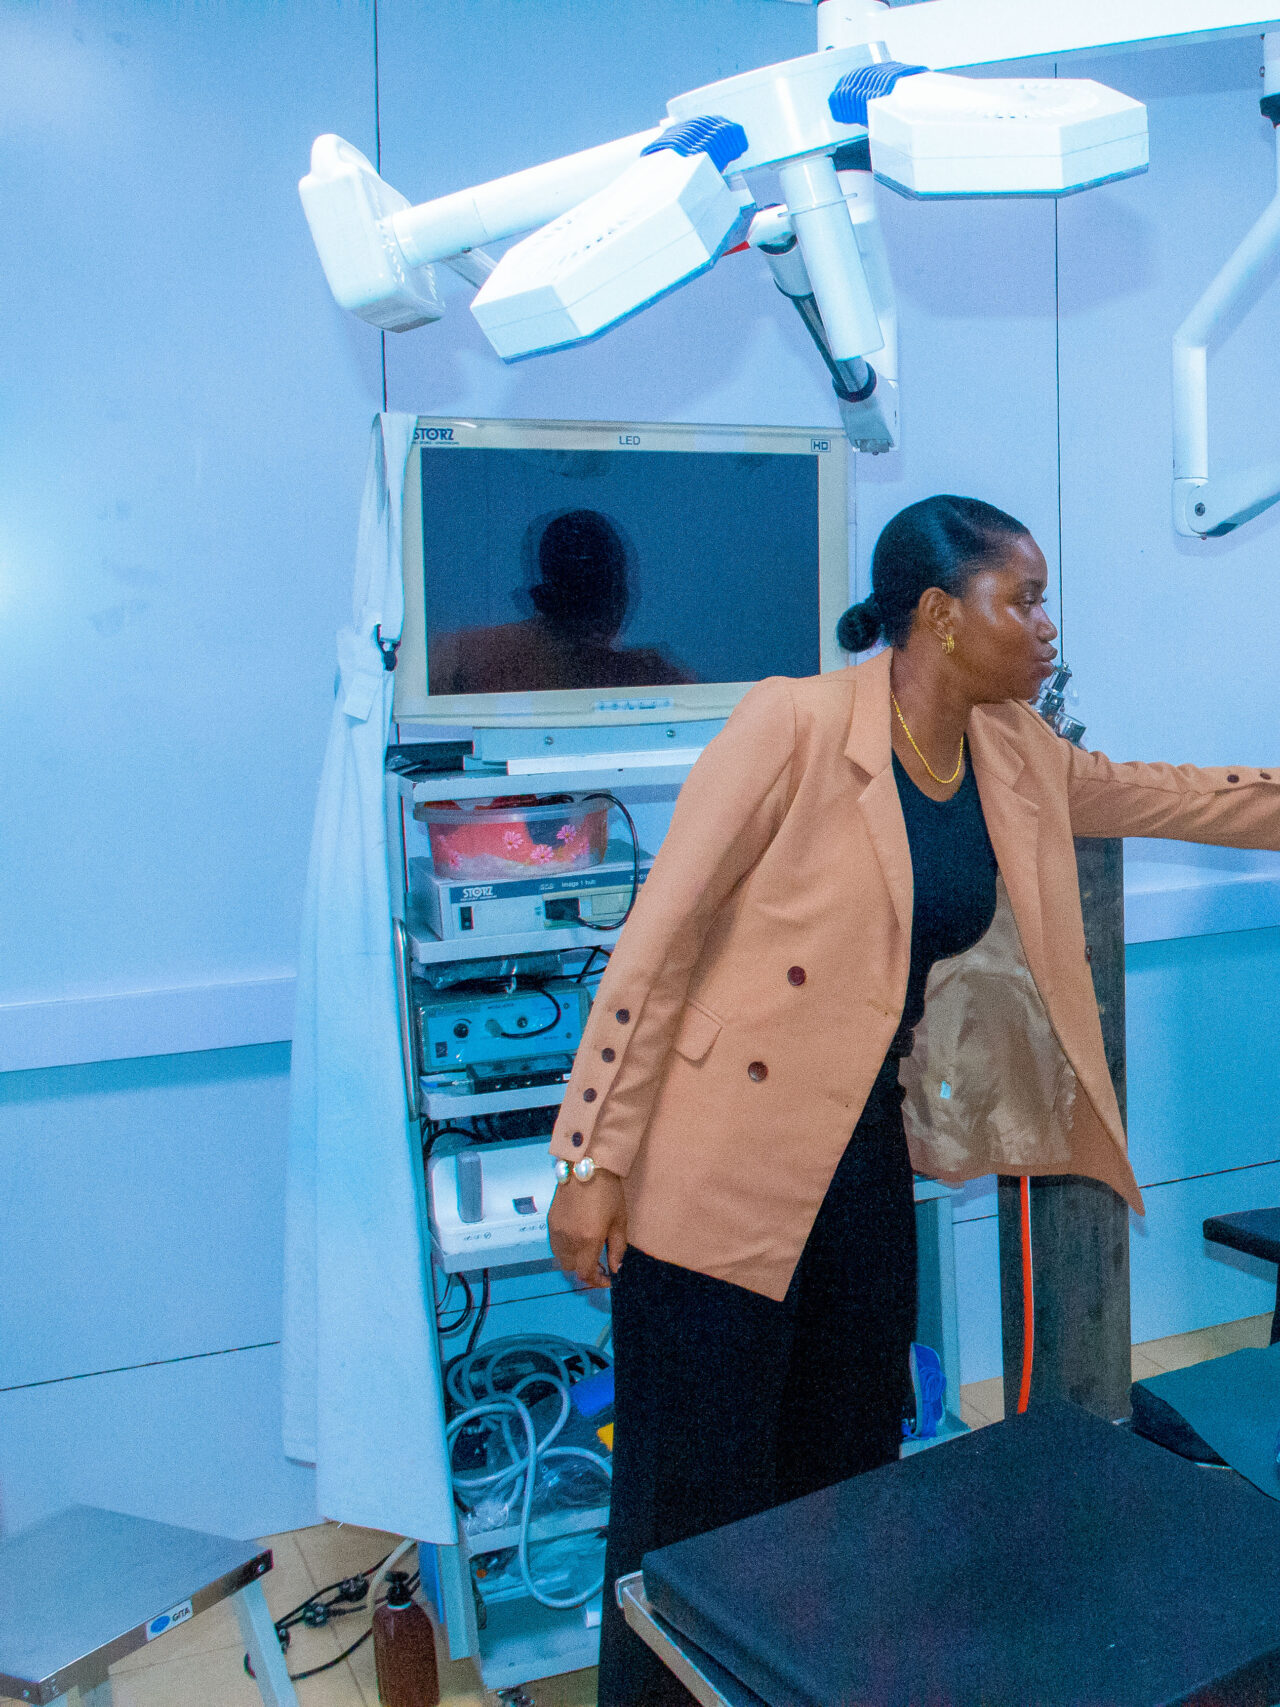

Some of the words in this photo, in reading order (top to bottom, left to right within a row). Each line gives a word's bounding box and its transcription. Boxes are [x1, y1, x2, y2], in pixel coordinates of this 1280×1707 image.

[414, 427, 454, 440] STORZ
[619, 435, 640, 445] LED
[813, 440, 828, 450] HD
[462, 886, 494, 898] STORZ
[172, 1607, 190, 1621] GITA
